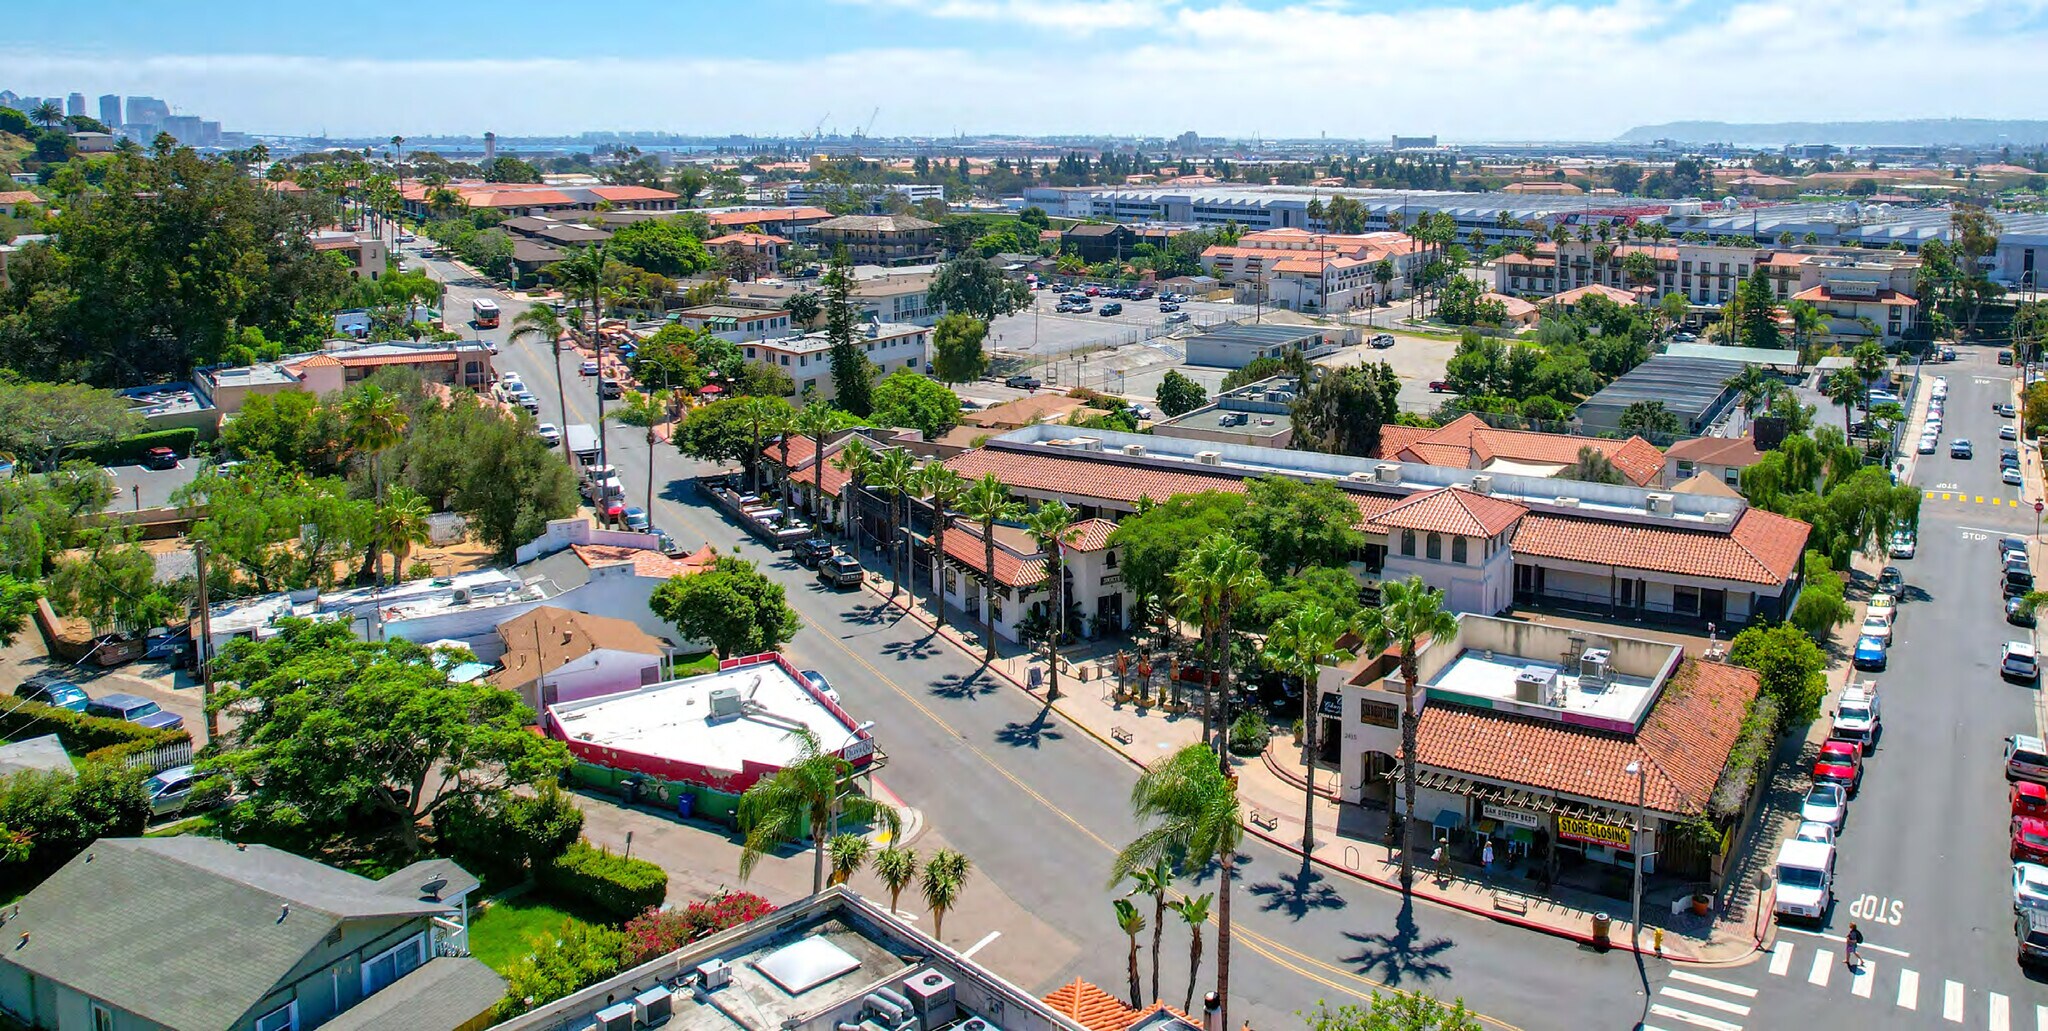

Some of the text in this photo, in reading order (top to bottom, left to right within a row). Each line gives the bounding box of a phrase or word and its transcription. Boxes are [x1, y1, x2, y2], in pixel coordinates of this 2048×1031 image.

[1962, 532, 1987, 541] STOP
[1484, 806, 1496, 814] SAN
[1520, 814, 1537, 824] BEST
[1561, 818, 1627, 842] STORE CLOSING
[1562, 832, 1598, 843] EVERYTHING
[1850, 893, 1904, 926] STOP
